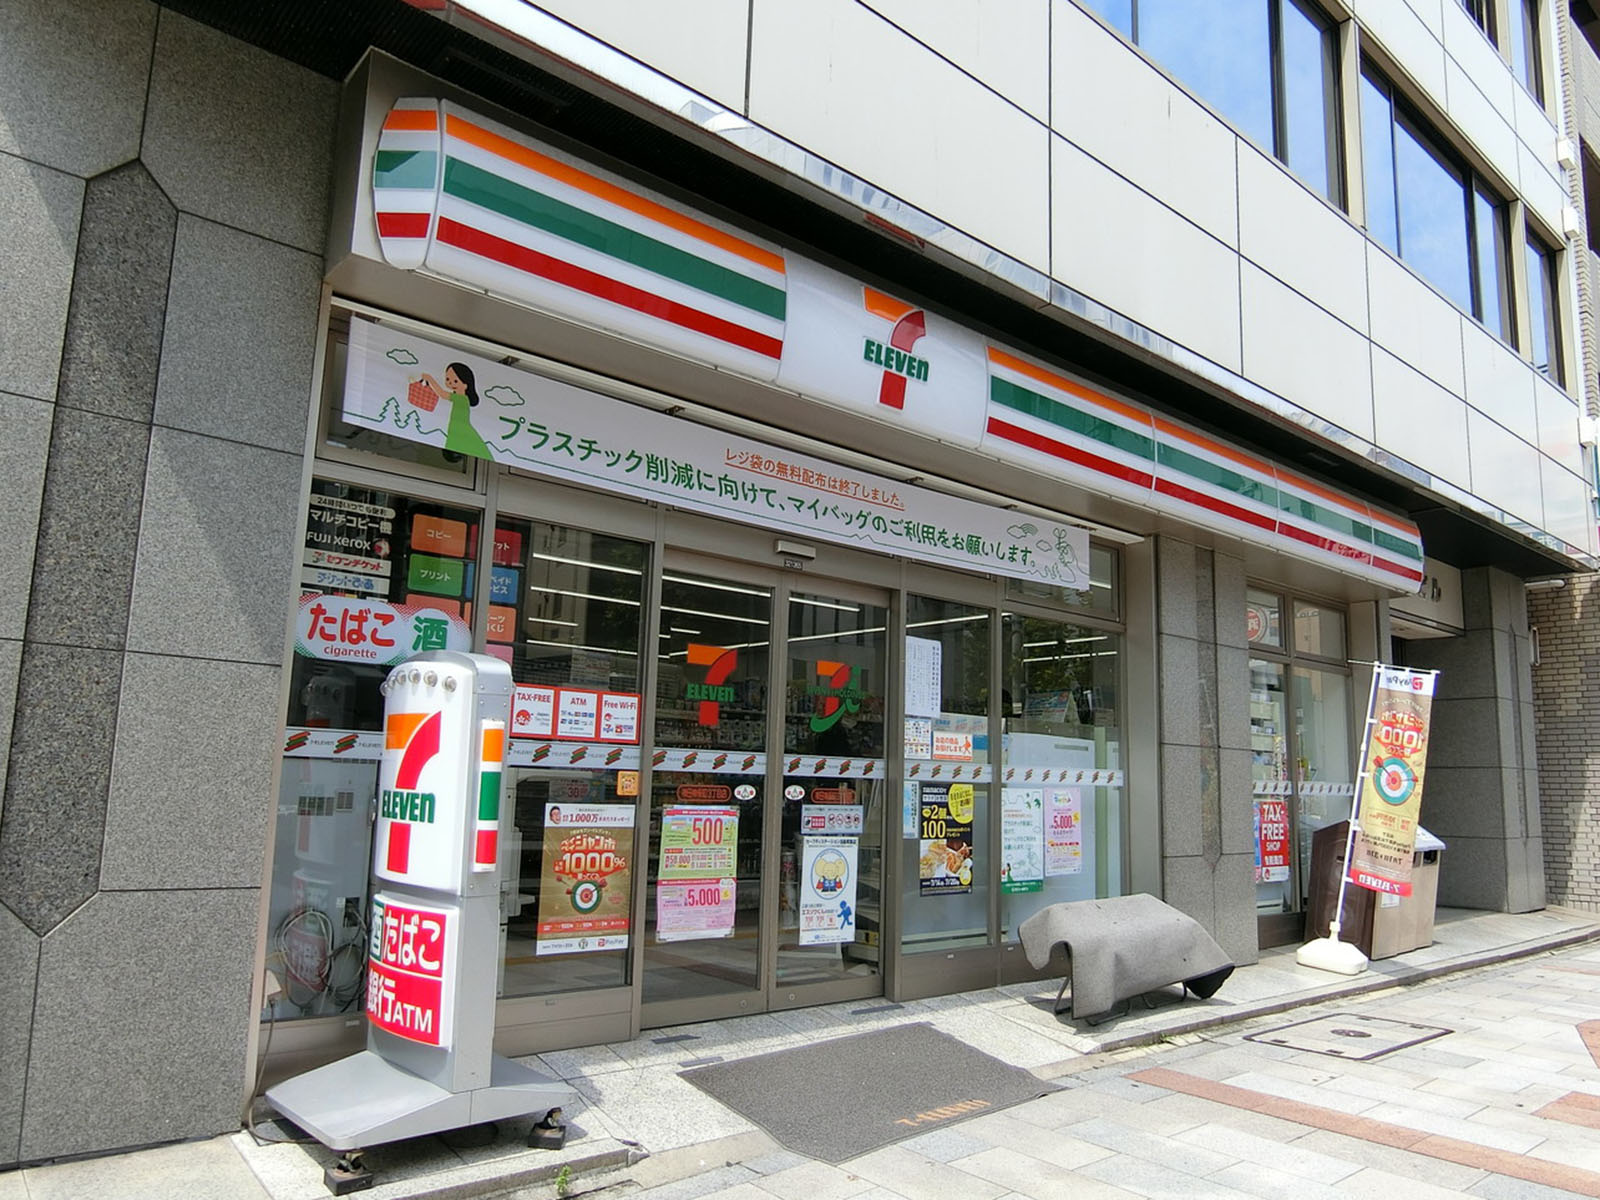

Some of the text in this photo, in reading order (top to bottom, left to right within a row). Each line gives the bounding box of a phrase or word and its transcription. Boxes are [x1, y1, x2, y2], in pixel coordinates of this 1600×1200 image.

[725, 447, 905, 508] レジ袋の無料配布は終了しました。
[499, 415, 1037, 568] プラスチック削減に向けて、マイバッグのご利用をお願いします。
[310, 509, 392, 535] マルチコピー機
[306, 531, 331, 544] FUJI
[426, 528, 452, 539] コピー
[493, 541, 511, 551] ット
[326, 554, 383, 571] セブンチケット
[419, 569, 451, 581] プリント
[307, 603, 449, 652] たばこ 酒
[323, 644, 377, 660] cigarette
[516, 692, 552, 703] TAX-FREE
[570, 697, 587, 706] ATM
[603, 700, 637, 710] Free Wi-Fi
[692, 818, 723, 845] 500
[922, 820, 947, 838] 100
[1261, 823, 1285, 841] FREE
[1265, 841, 1281, 852] SHOP
[687, 888, 721, 907] 5,000
[384, 910, 442, 971] たばこ
[367, 967, 433, 1034] 銀行ATM
